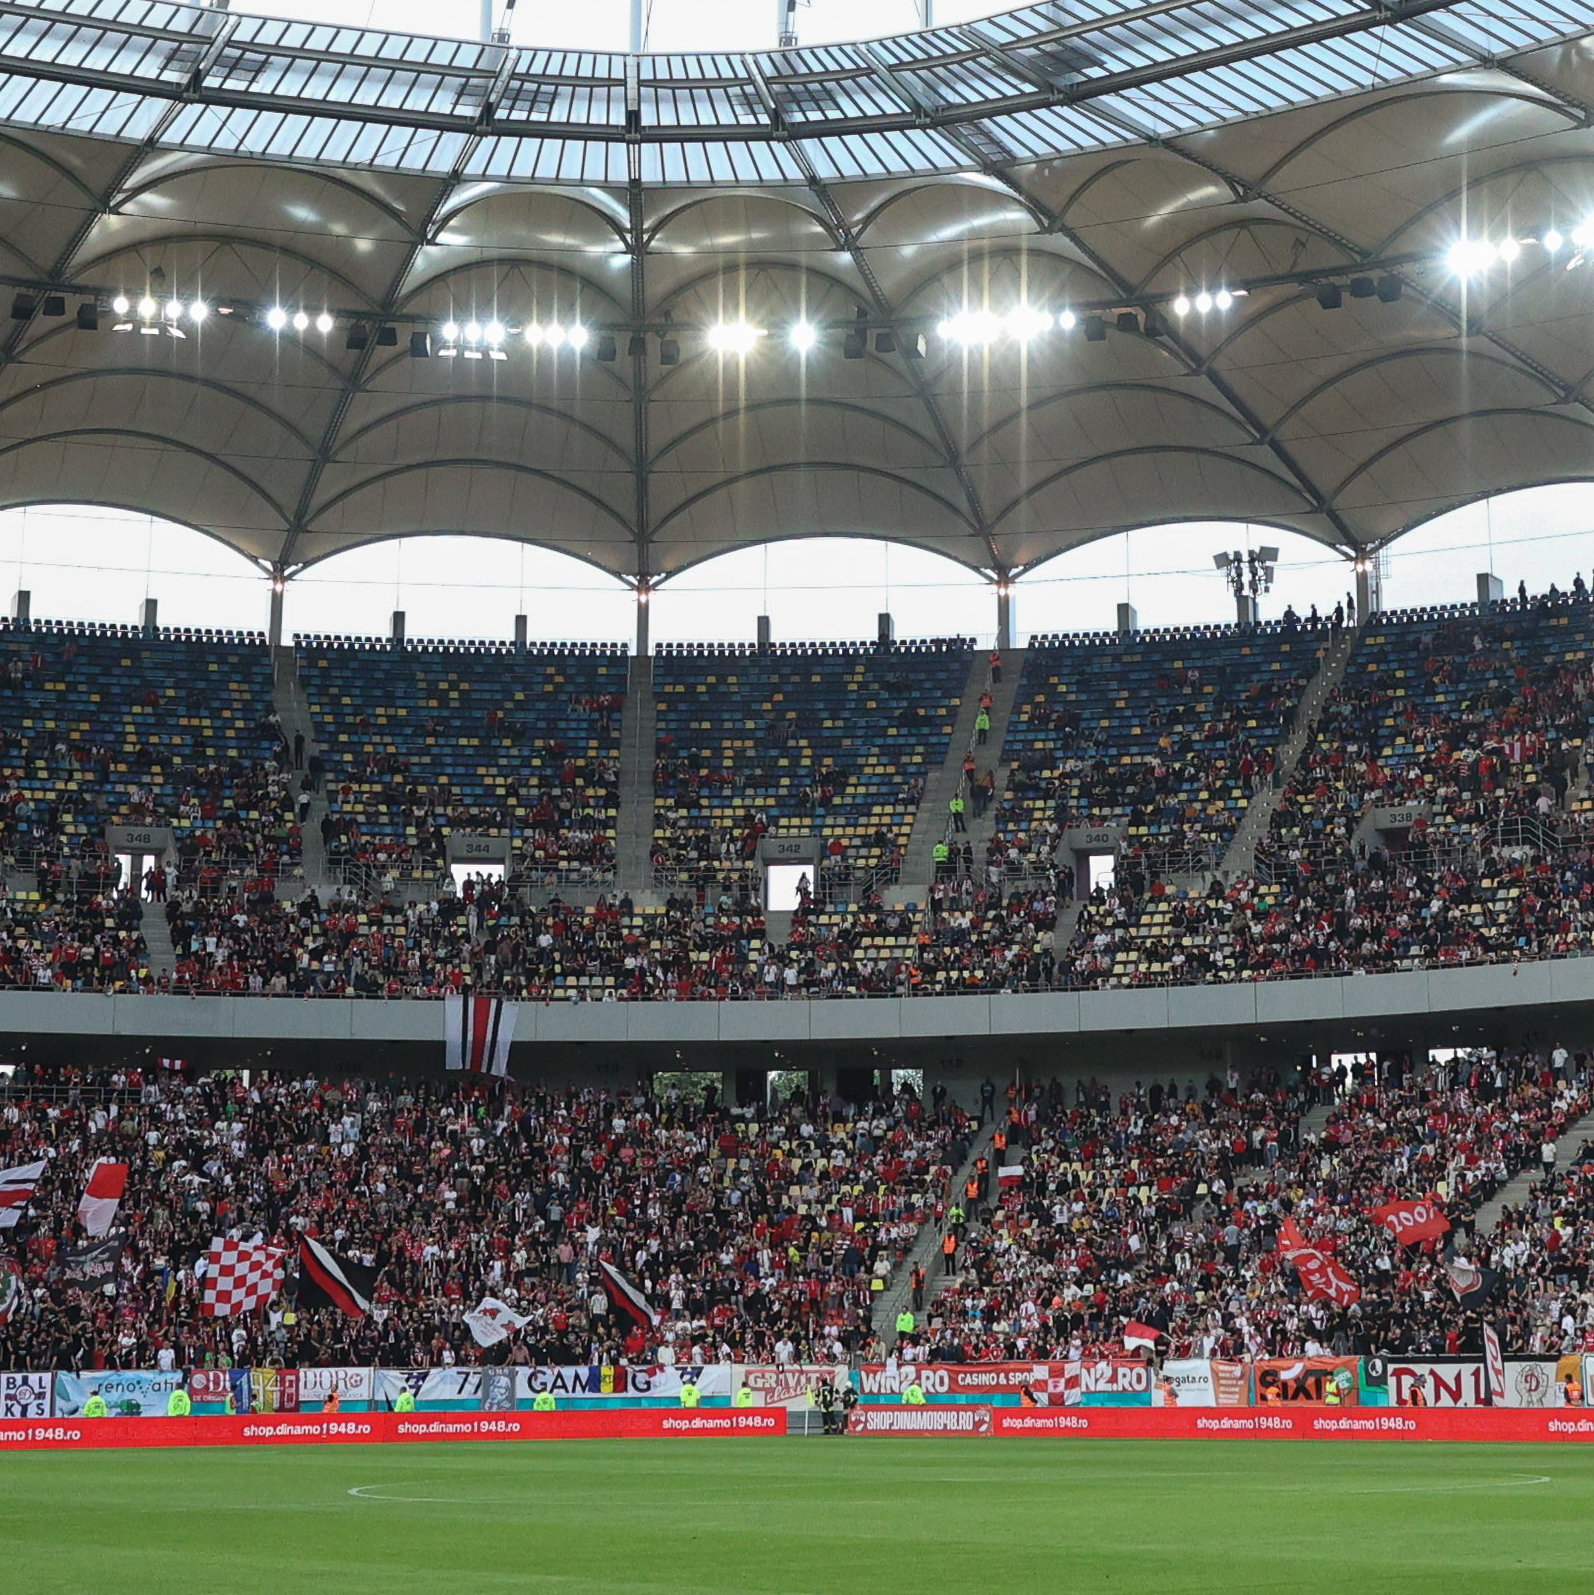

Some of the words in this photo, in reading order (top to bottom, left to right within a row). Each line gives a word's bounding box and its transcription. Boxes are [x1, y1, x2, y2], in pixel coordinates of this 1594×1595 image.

[1389, 812, 1413, 824] 338
[1085, 833, 1110, 844] 340
[465, 843, 490, 854] 344
[777, 843, 802, 854] 342
[527, 1369, 652, 1394] GAMG
[957, 1372, 997, 1386] CASINO
[998, 1372, 1008, 1386] &
[397, 1420, 521, 1436] shop.dinamo1948.ro
[662, 1415, 776, 1431] shop.dinamo1948.ro
[866, 1411, 973, 1431] SHOP.DINAMO1948.RO
[1001, 1415, 1088, 1431] shop.dinamo1948.ro
[1196, 1417, 1293, 1433] shop.dinamo1948.ro
[1313, 1416, 1416, 1433] shop.dinamo1948.ro
[242, 1421, 371, 1438] shop.dinamo1948.ro
